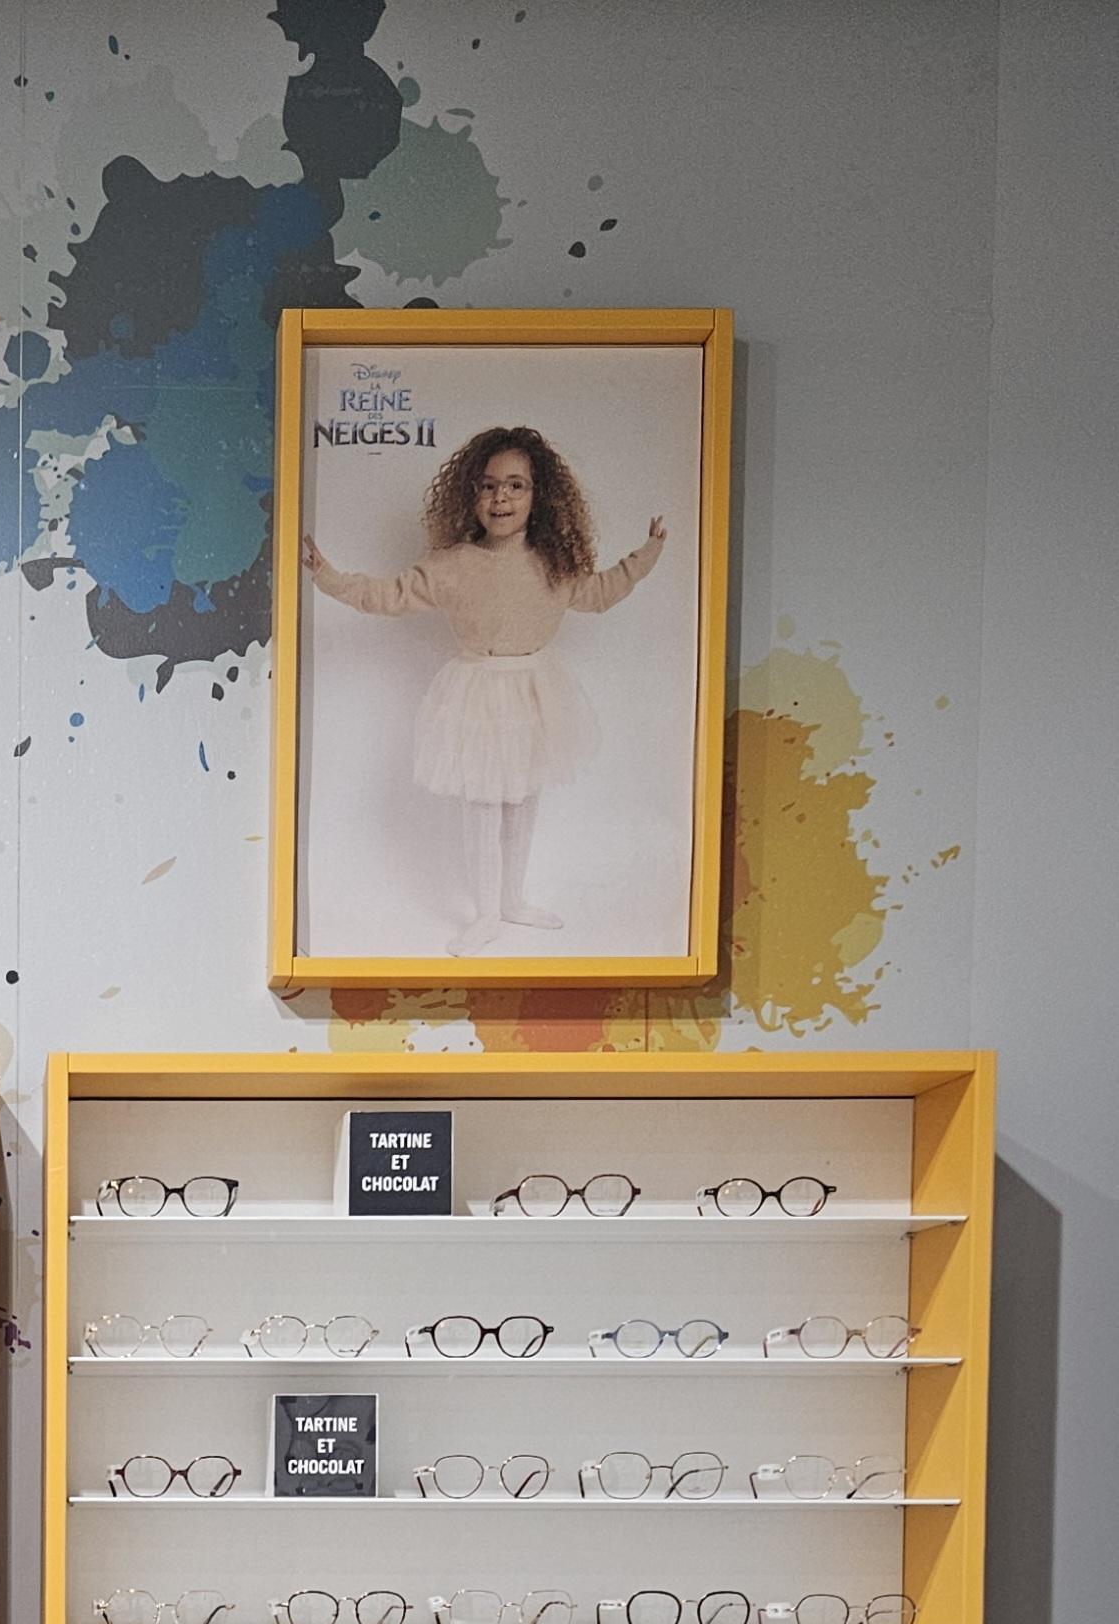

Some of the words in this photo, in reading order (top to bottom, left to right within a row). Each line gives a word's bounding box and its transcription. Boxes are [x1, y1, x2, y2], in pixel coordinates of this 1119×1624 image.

[351, 363, 401, 384] Disney
[340, 389, 412, 412] REINE
[313, 418, 411, 448] NEIGES
[415, 418, 437, 448] II
[369, 1132, 432, 1148] TARTINE
[391, 1154, 410, 1170] ET
[361, 1176, 439, 1191] CHOCOLAT
[295, 1417, 358, 1432] TARTINE
[317, 1438, 336, 1453] ET
[287, 1459, 364, 1474] CHOCOLAT
